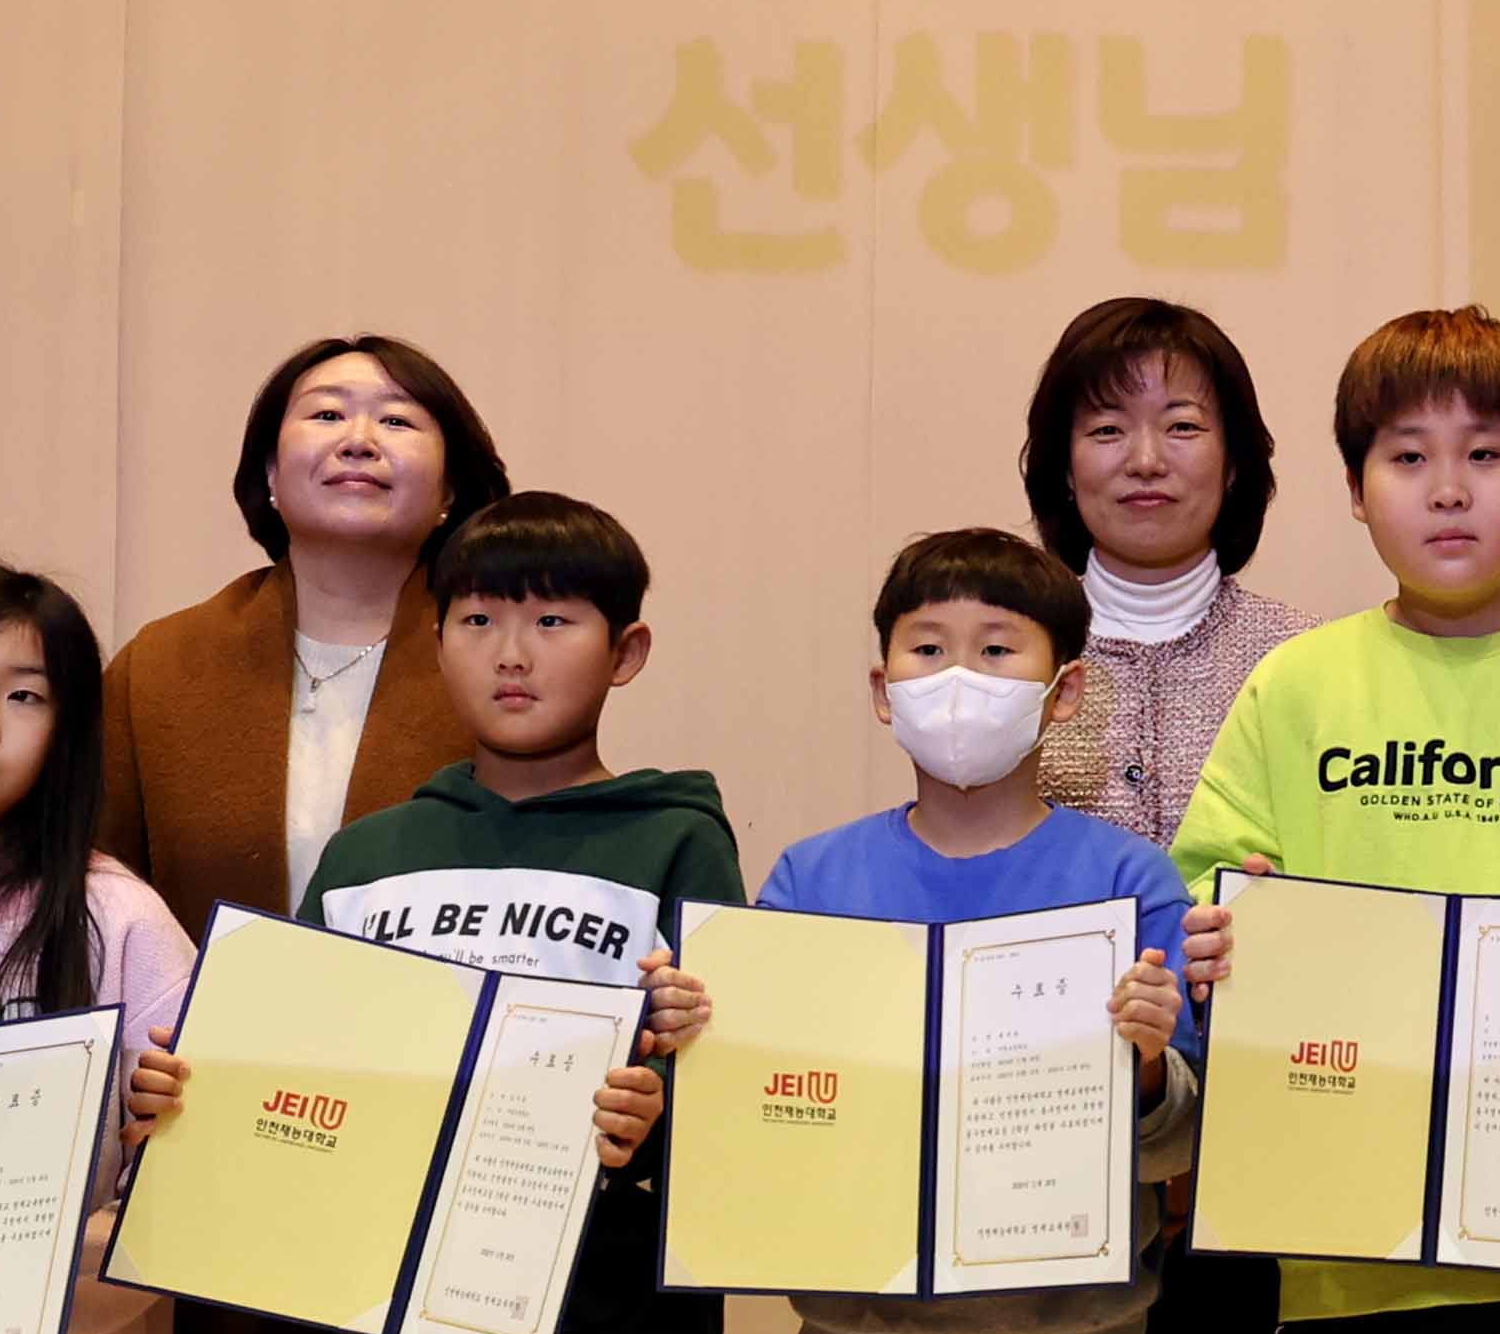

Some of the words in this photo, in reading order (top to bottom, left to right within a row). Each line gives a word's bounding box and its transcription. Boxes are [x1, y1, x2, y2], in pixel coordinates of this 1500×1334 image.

[625, 28, 1294, 274] 선생님
[1359, 794, 1421, 807] GOLDEN
[1426, 792, 1470, 806] STATE
[1475, 797, 1494, 808] OF
[431, 903, 489, 936] BE
[500, 902, 631, 961] NICER
[468, 951, 485, 965] be
[491, 953, 540, 968] smarter
